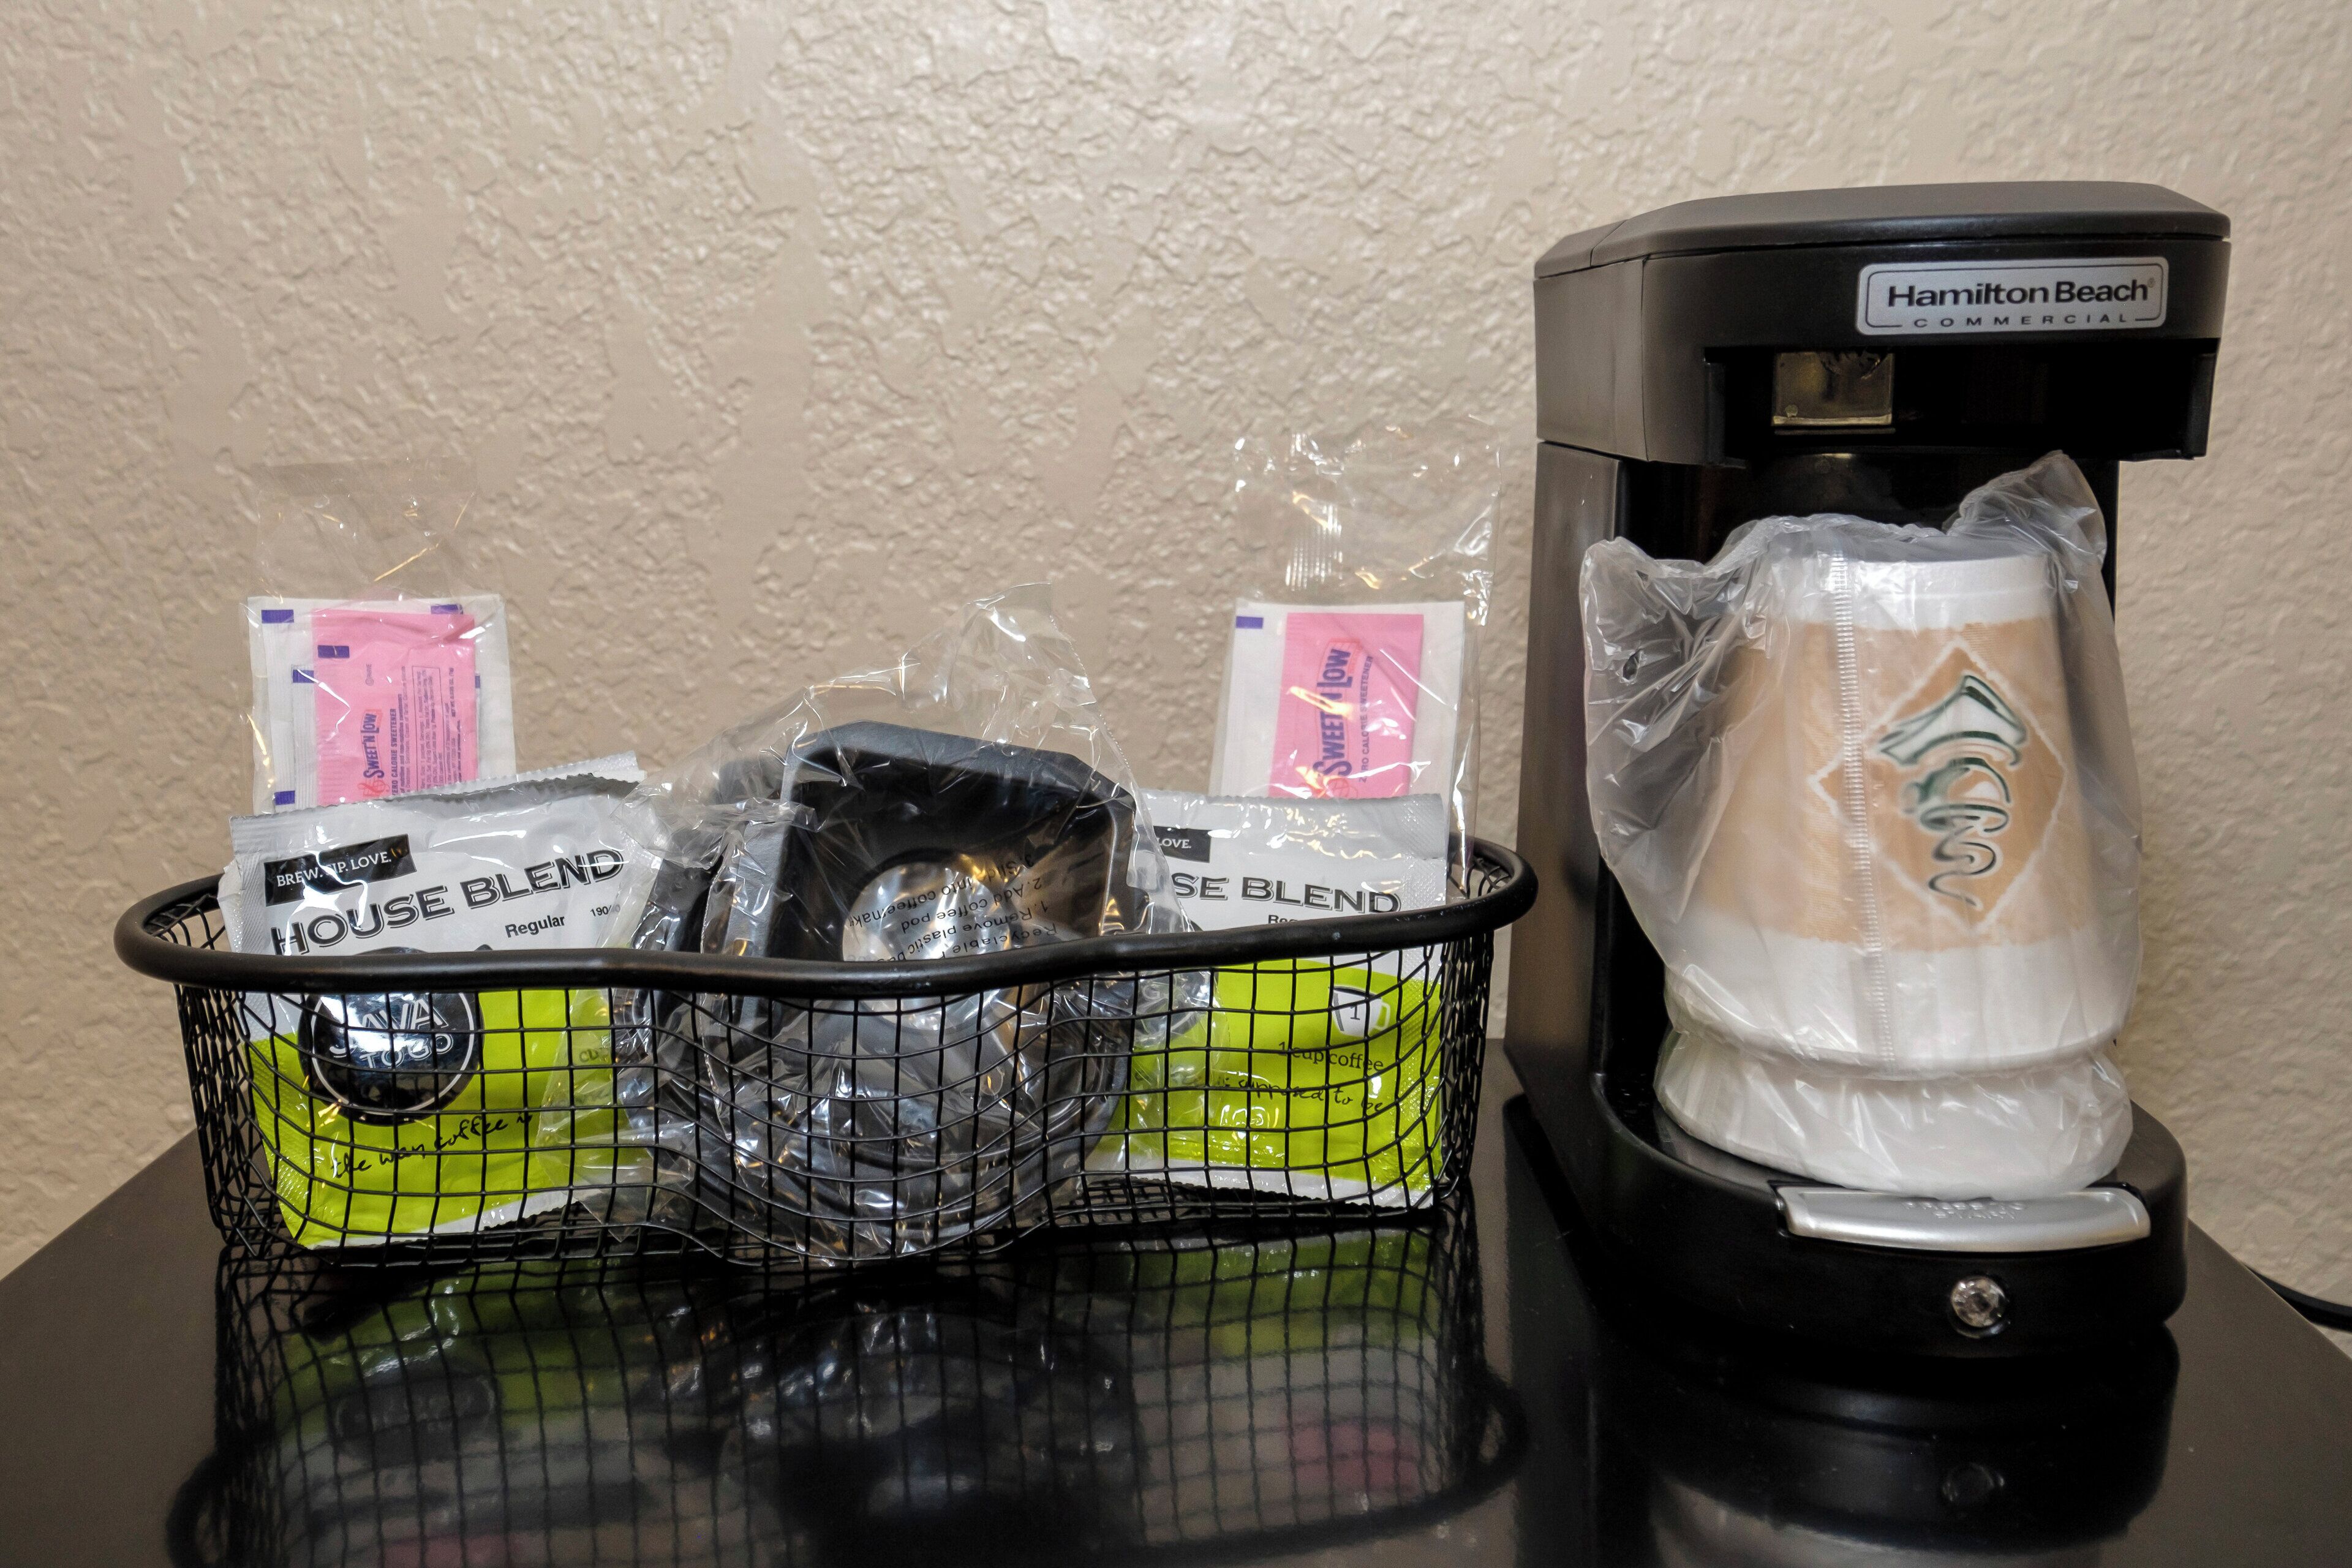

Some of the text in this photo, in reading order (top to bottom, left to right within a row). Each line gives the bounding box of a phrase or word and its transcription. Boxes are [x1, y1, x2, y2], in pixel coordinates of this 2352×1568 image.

[1888, 282, 2048, 307] Hamilton
[1913, 314, 2127, 328] COMMERCIAL
[1316, 648, 1353, 688] LOW
[1359, 656, 1374, 712] SWEETENER
[360, 713, 385, 779] SWEET'N LOW
[1360, 714, 1370, 755] CALORIE
[276, 867, 323, 887] BREW.
[350, 851, 392, 870] LOVE.
[942, 877, 973, 897] into
[270, 848, 625, 956] HOUSE BLEND
[900, 877, 1042, 933] 2. Add coffee pod
[1241, 876, 1403, 914] BLEND
[505, 914, 565, 939] Regular
[907, 900, 1048, 956] 1. Remove plastic
[952, 923, 1057, 956] Recyclable
[1292, 1047, 1325, 1065] cup
[1329, 1052, 1384, 1071] coffee
[1333, 1087, 1354, 1105] to
[434, 1115, 508, 1151] coffee
